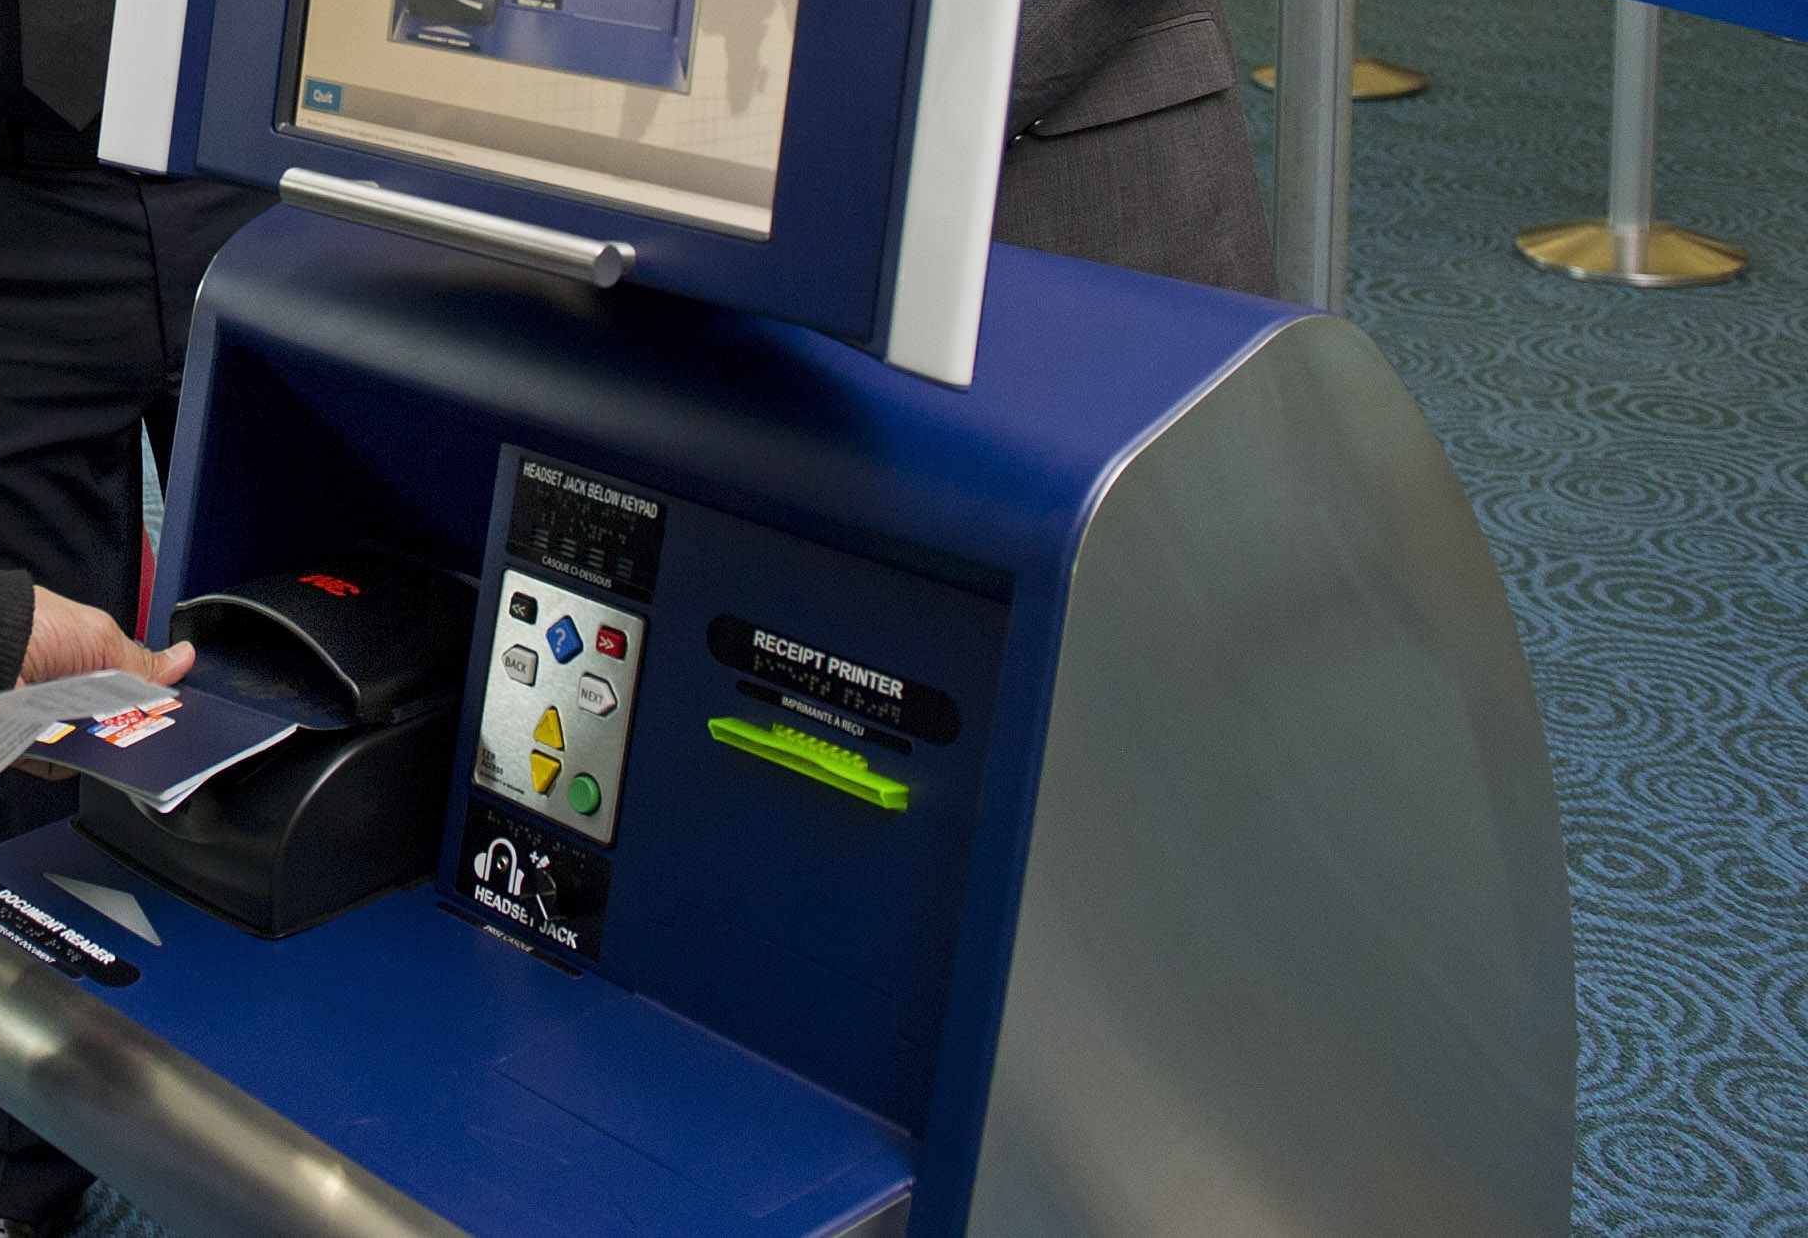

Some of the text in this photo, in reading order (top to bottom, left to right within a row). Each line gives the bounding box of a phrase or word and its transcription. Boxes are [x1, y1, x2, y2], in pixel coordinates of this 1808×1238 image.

[313, 89, 333, 104] Quit
[523, 462, 659, 519] HEADSET JACK BELOW KEYPAD
[542, 555, 570, 574] CASQUE
[504, 656, 527, 675] BACK
[753, 629, 904, 700] RECEIPT PRINTER
[581, 687, 604, 705] NEXT
[782, 695, 833, 726] IMPRIMANTE
[841, 719, 865, 737] REÇU
[59, 928, 117, 966] READER
[539, 919, 578, 950] JACK
